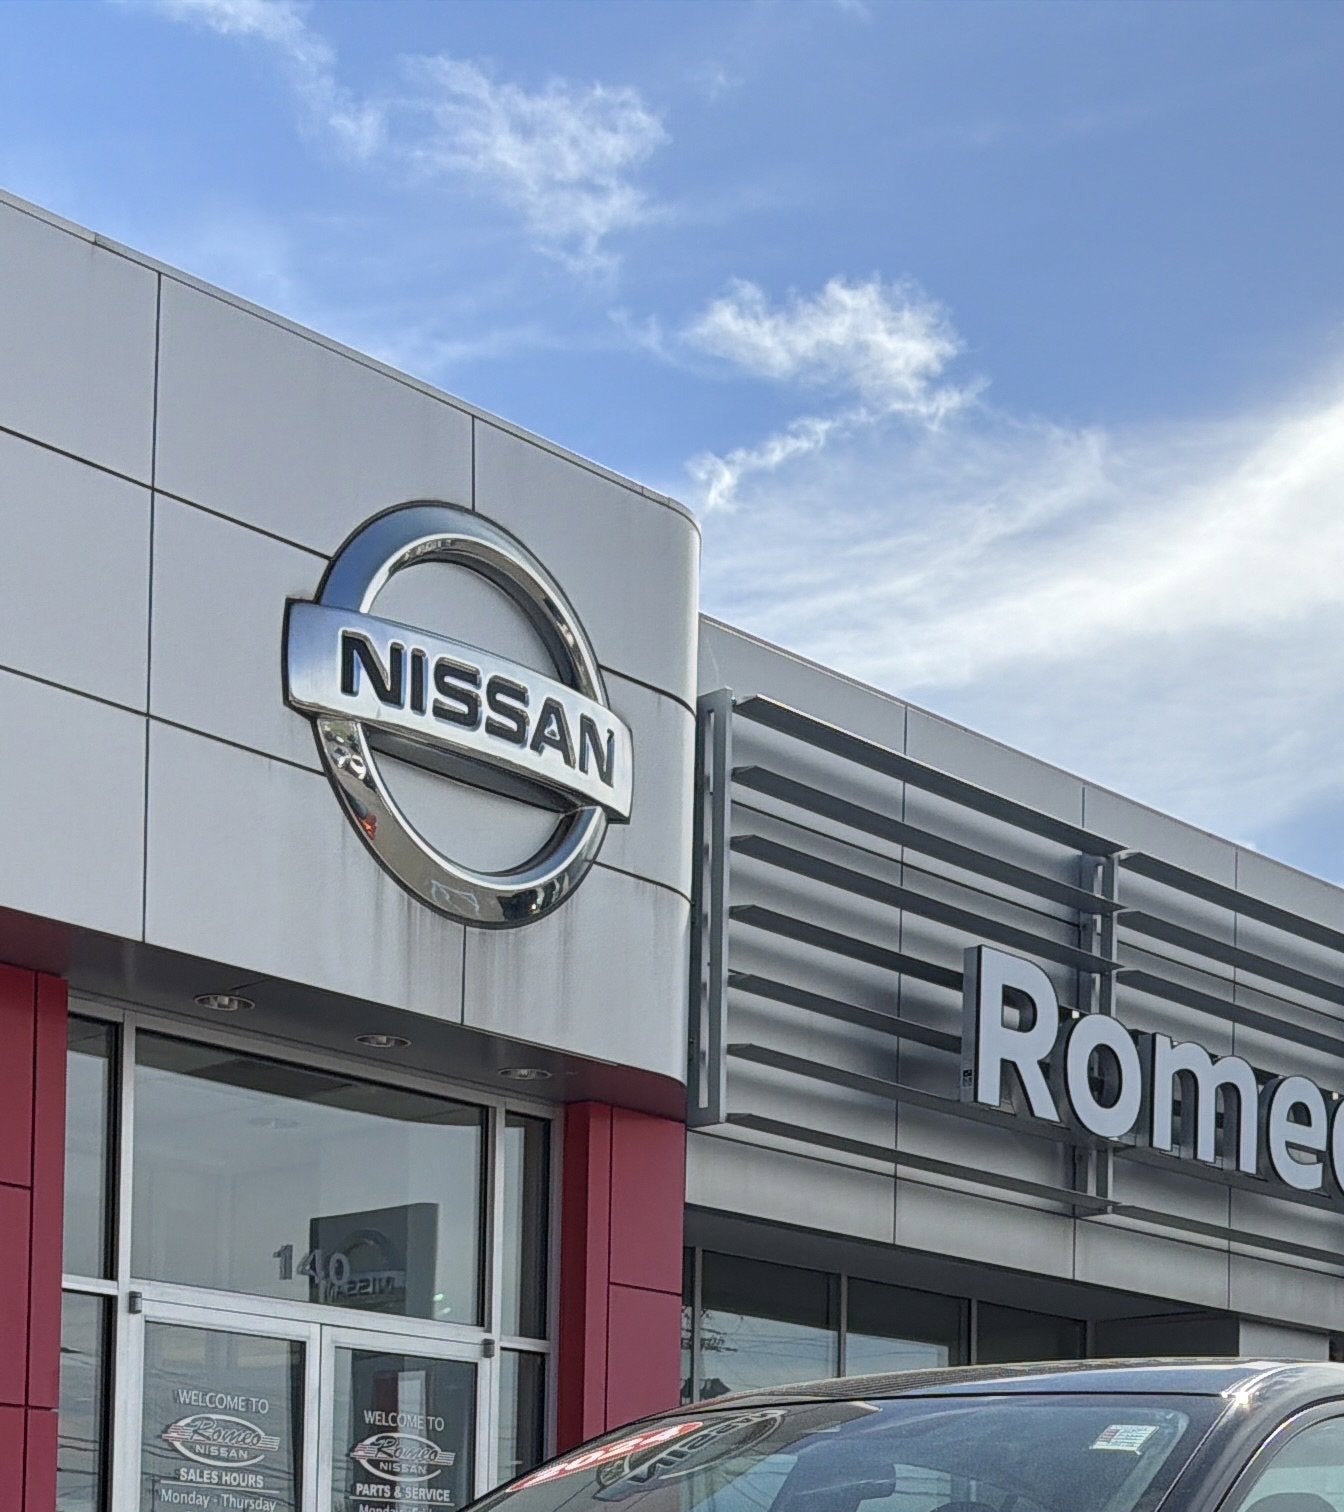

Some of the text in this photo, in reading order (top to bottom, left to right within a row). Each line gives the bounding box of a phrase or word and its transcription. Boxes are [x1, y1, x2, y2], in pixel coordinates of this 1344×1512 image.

[338, 628, 616, 789] NISSAN
[273, 1243, 351, 1286] 140
[177, 1388, 269, 1414] WELCOME TO
[189, 1416, 262, 1446] Romeo
[363, 1409, 445, 1431] WELCOME TO
[195, 1444, 249, 1460] NISSAN
[374, 1435, 439, 1462] Romeo
[179, 1467, 264, 1488] SALES HOURS
[379, 1461, 428, 1475] NISSAN
[160, 1488, 210, 1509] Monday
[356, 1482, 451, 1502] PARTS & SERVICE
